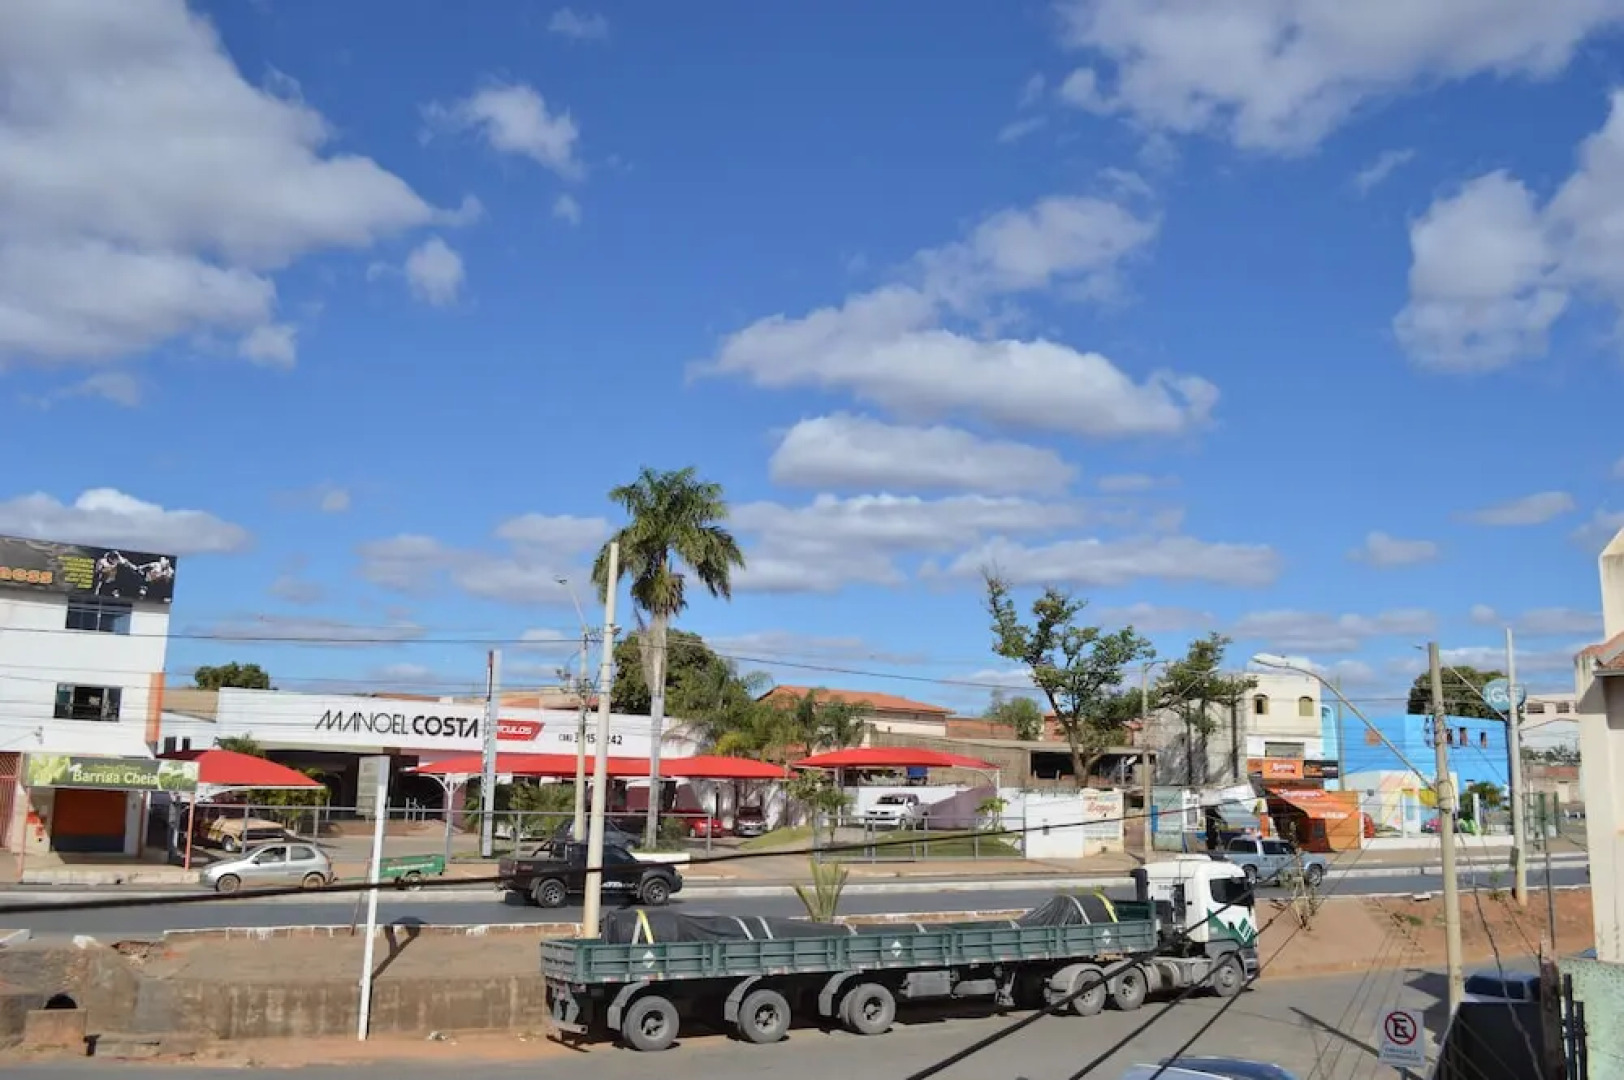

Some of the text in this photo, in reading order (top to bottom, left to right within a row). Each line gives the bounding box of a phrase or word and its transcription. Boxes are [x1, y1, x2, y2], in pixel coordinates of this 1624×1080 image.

[315, 709, 478, 738] MANOEL COSTA
[72, 770, 159, 785] Barriga Cheia
